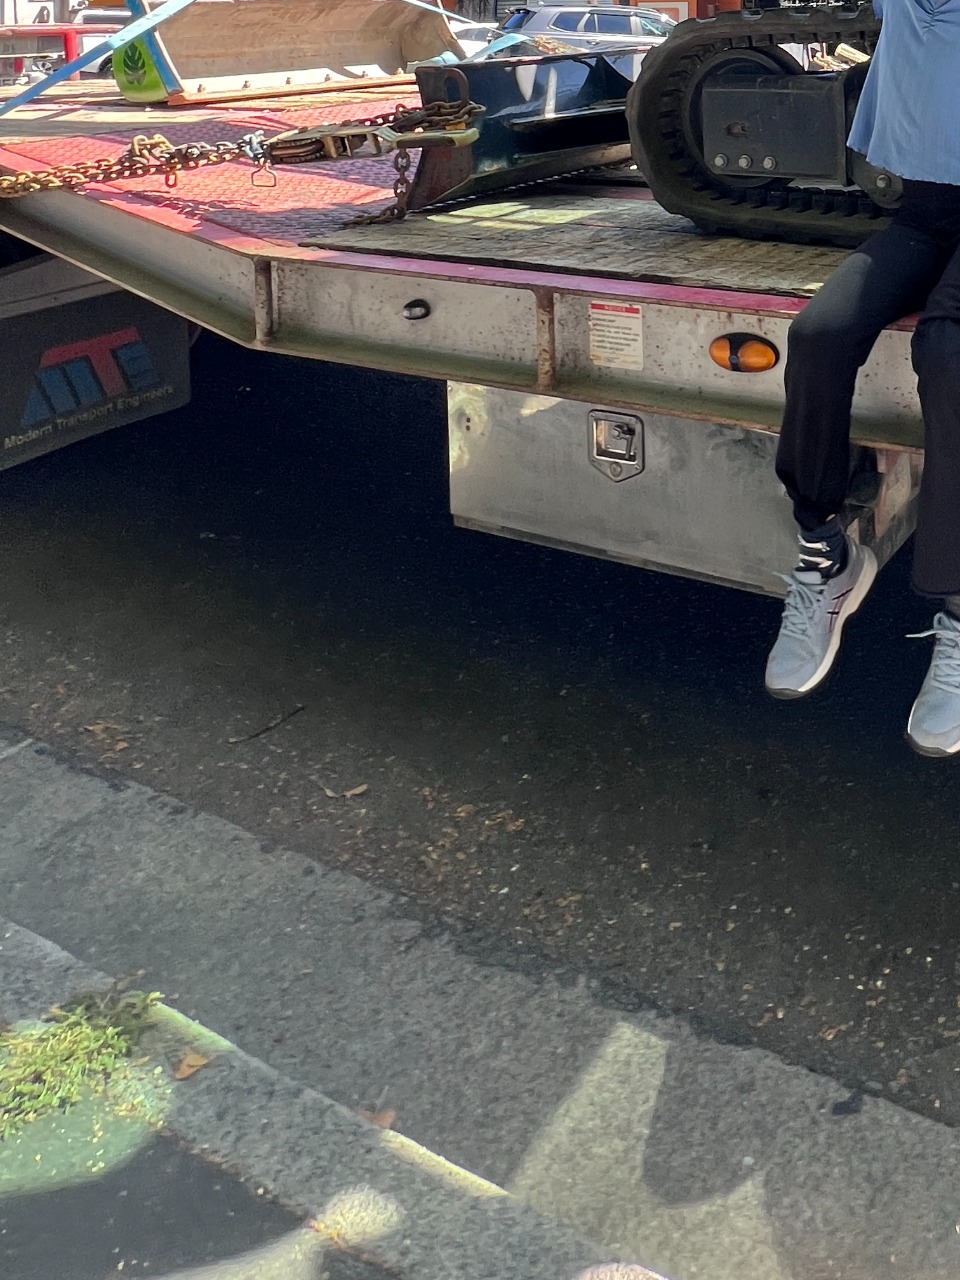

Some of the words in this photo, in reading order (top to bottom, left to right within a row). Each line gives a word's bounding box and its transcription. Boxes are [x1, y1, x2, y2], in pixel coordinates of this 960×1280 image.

[4, 423, 53, 450] Modern
[56, 401, 114, 430] Transport
[117, 384, 174, 411] Engineers
